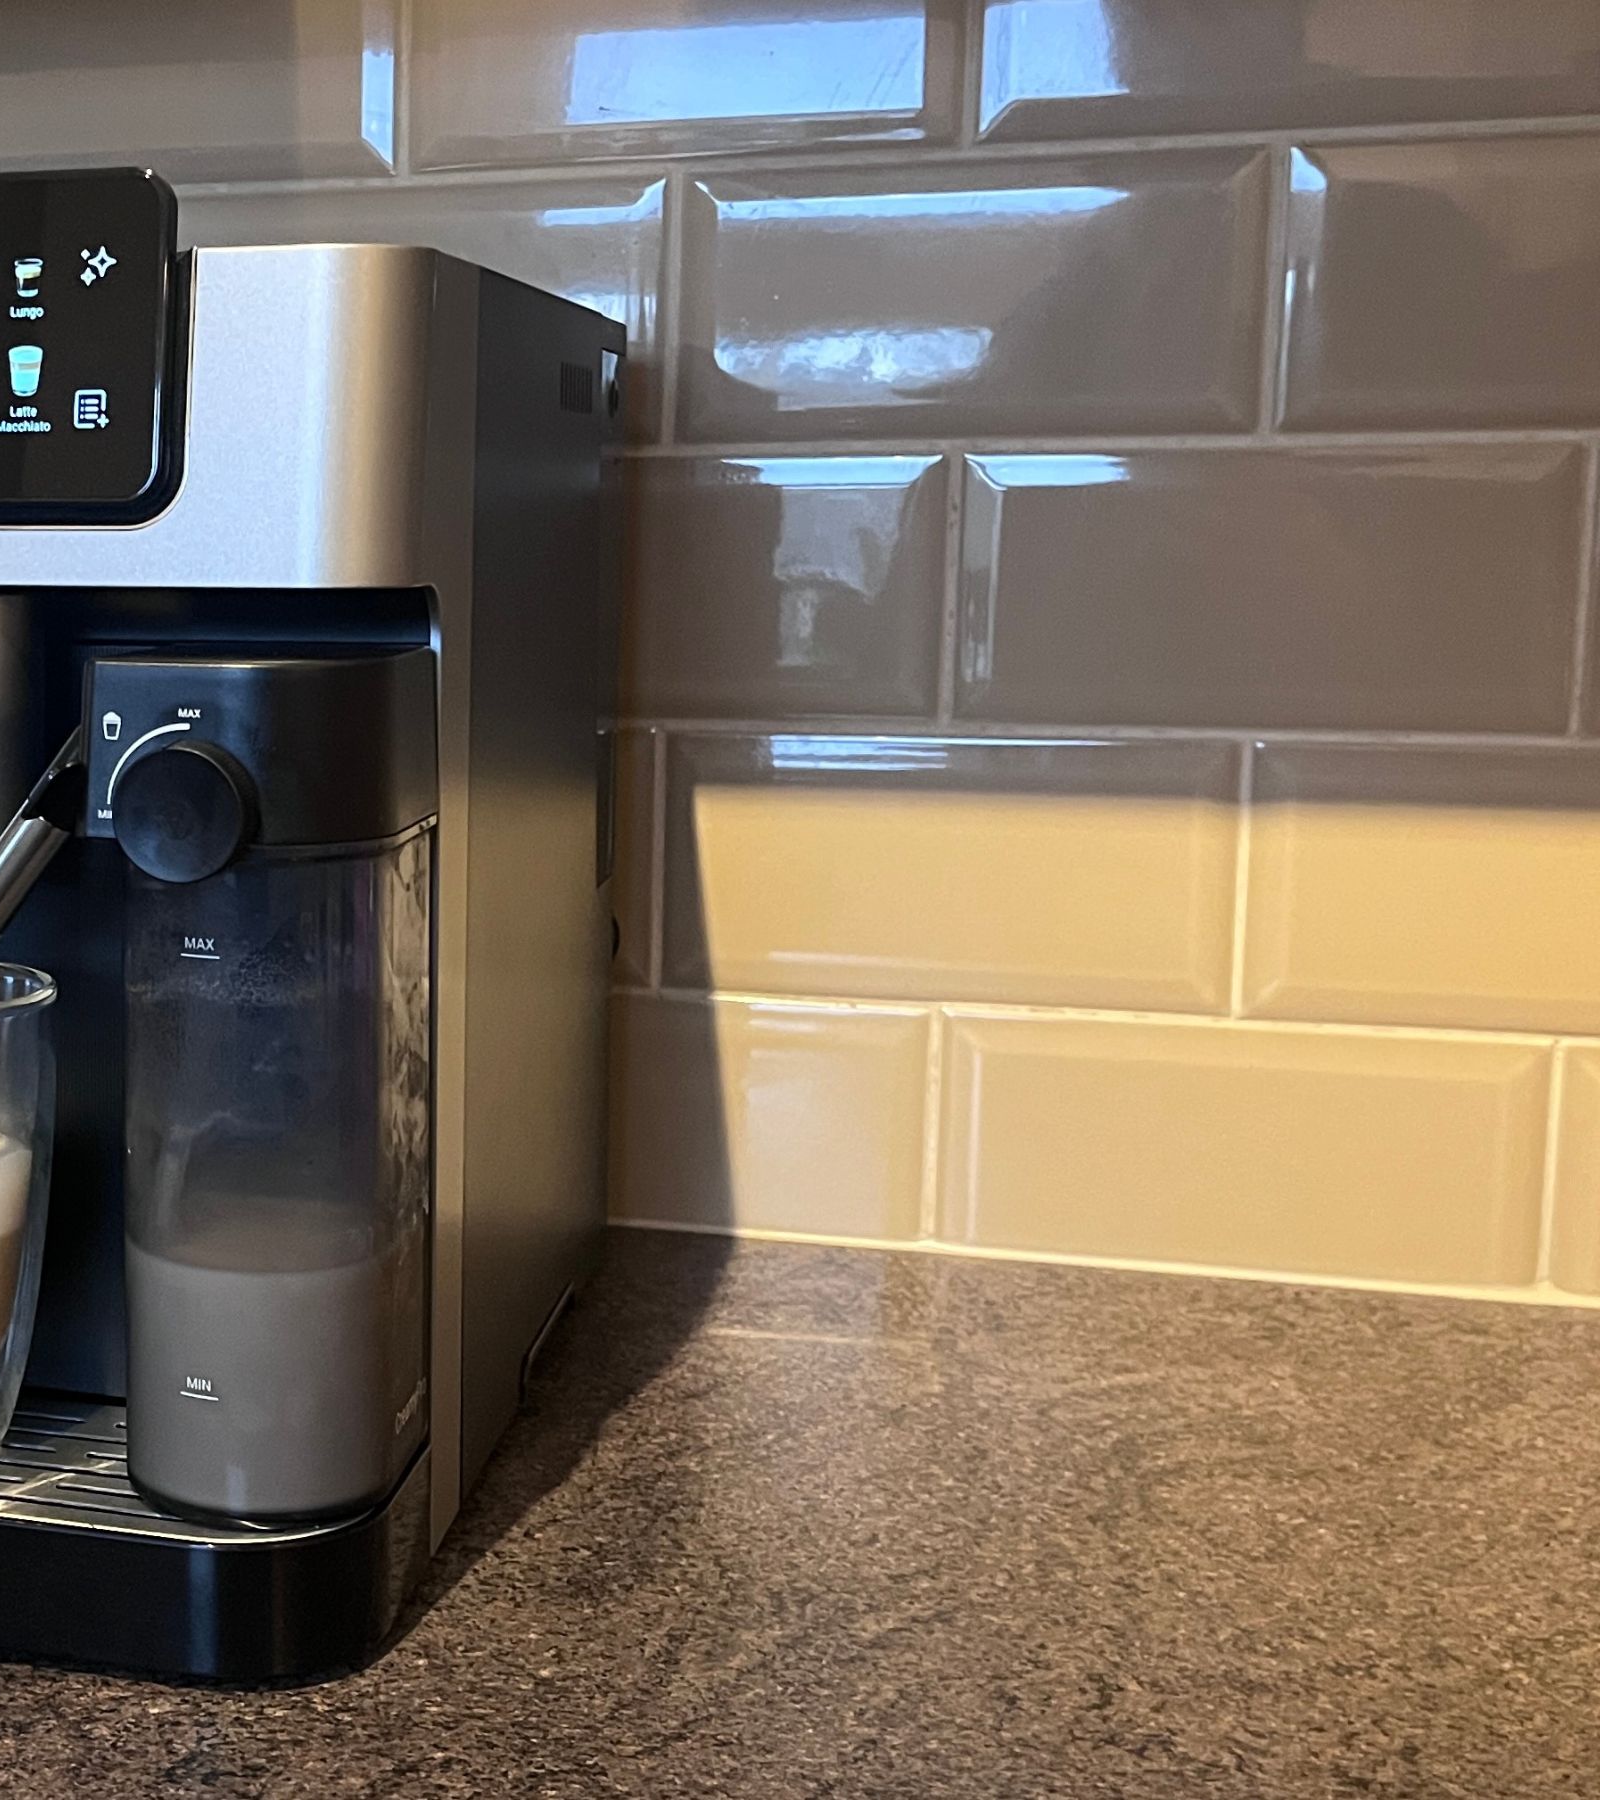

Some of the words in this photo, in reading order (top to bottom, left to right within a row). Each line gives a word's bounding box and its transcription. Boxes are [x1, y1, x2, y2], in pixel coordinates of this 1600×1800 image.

[9, 306, 45, 320] Lungo
[9, 406, 37, 418] Latte
[177, 708, 201, 719] MAX
[97, 809, 113, 820] MI
[184, 936, 215, 951] MAX
[186, 1376, 212, 1392] MIN
